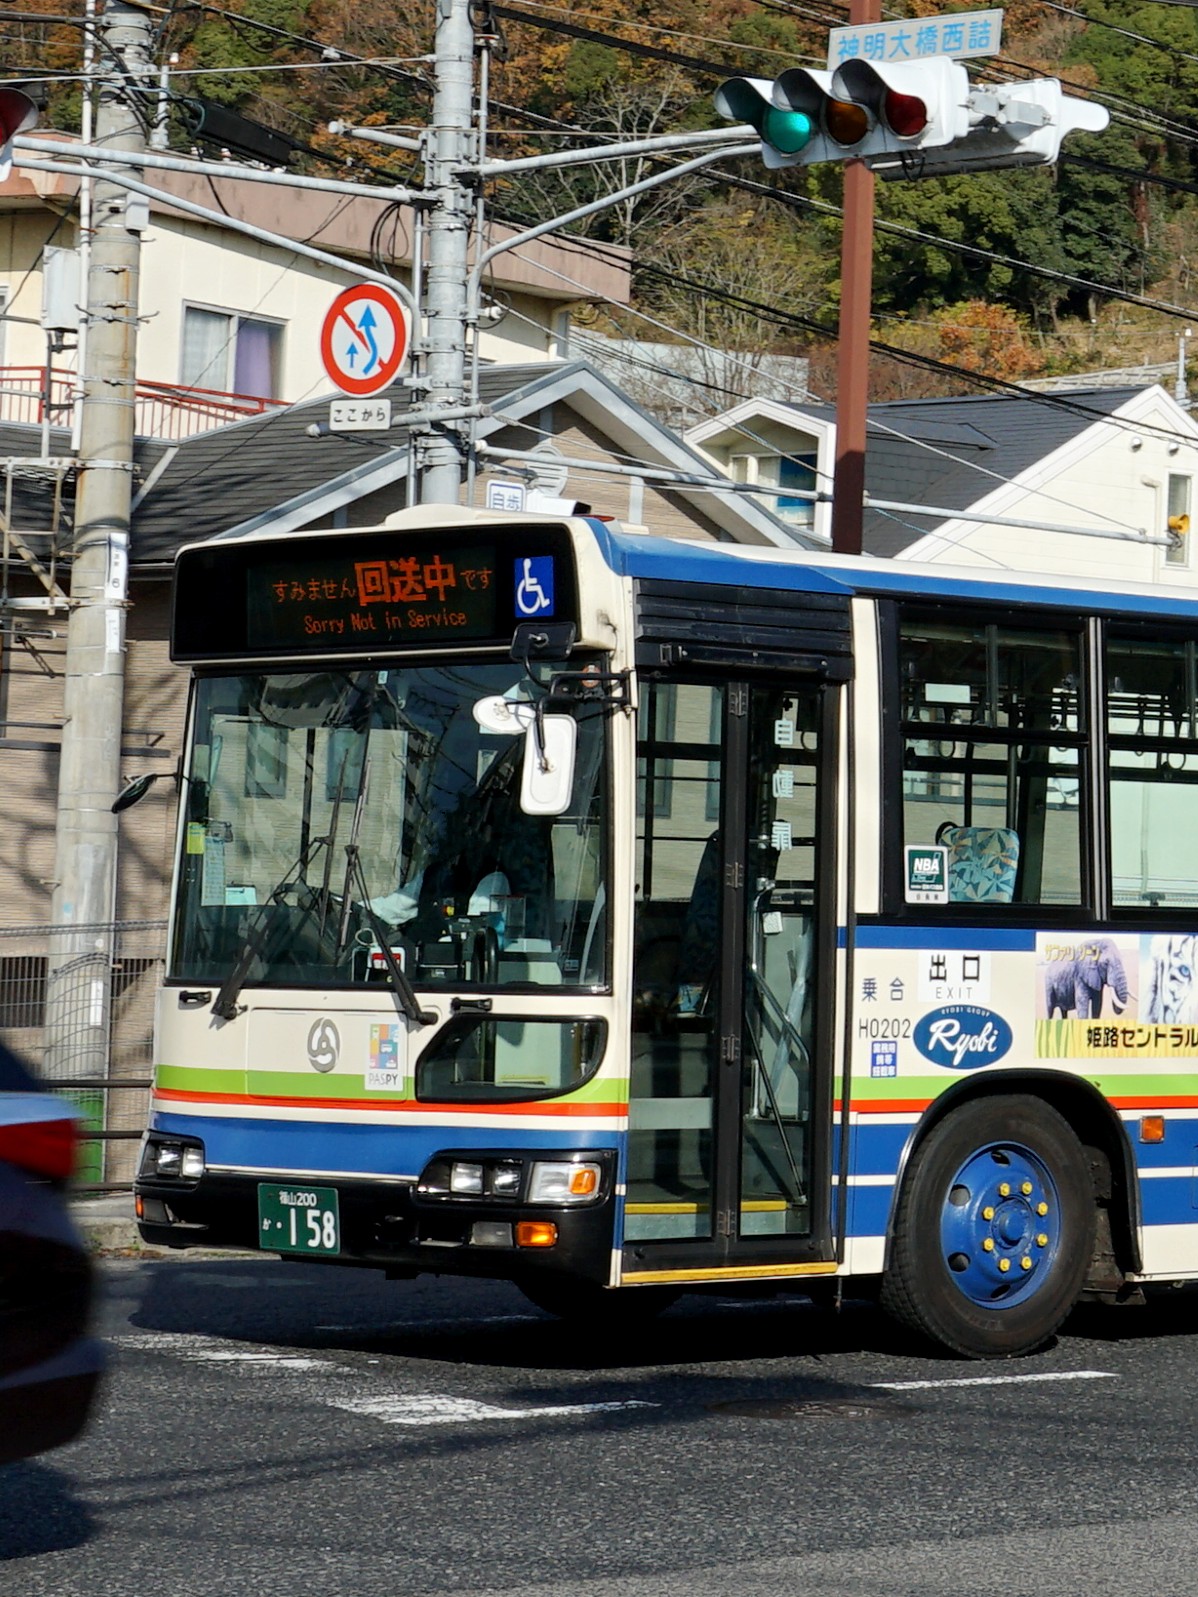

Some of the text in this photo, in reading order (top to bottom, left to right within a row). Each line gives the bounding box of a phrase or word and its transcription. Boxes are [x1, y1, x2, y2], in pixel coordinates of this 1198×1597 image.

[838, 19, 992, 61] 神明大橋西詰
[333, 407, 386, 423] ここから
[304, 608, 467, 634] Sorry Not in Service
[913, 858, 940, 872] NBA
[929, 953, 981, 982] 出口
[862, 977, 905, 1002] 乗合
[935, 986, 974, 999] EXIT
[858, 1018, 911, 1039] H0202
[928, 1018, 999, 1066] Ryobi
[368, 1073, 399, 1086] PASPY
